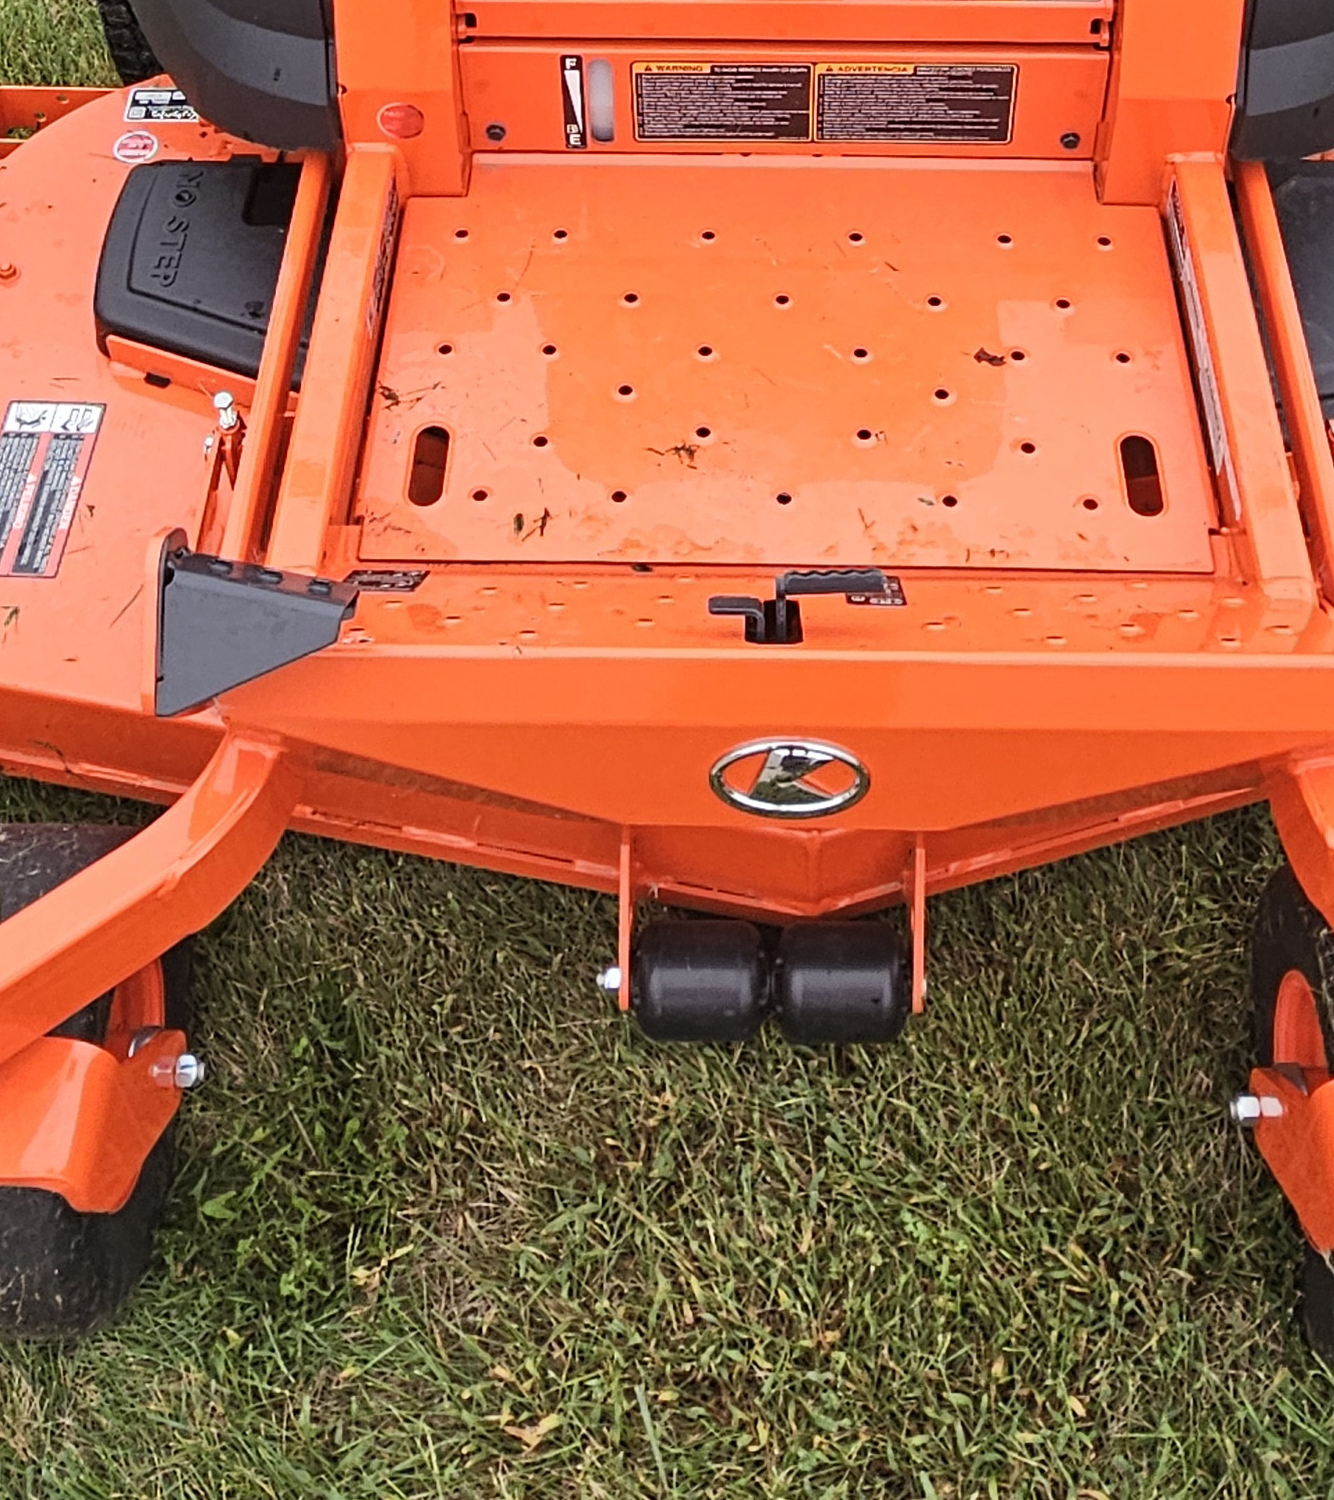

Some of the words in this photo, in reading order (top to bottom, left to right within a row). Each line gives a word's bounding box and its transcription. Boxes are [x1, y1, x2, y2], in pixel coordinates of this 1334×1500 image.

[565, 57, 578, 70] F
[837, 65, 909, 73] ADVERTENCIA
[569, 134, 582, 146] E
[171, 170, 205, 208] NO
[149, 215, 191, 288] STEP
